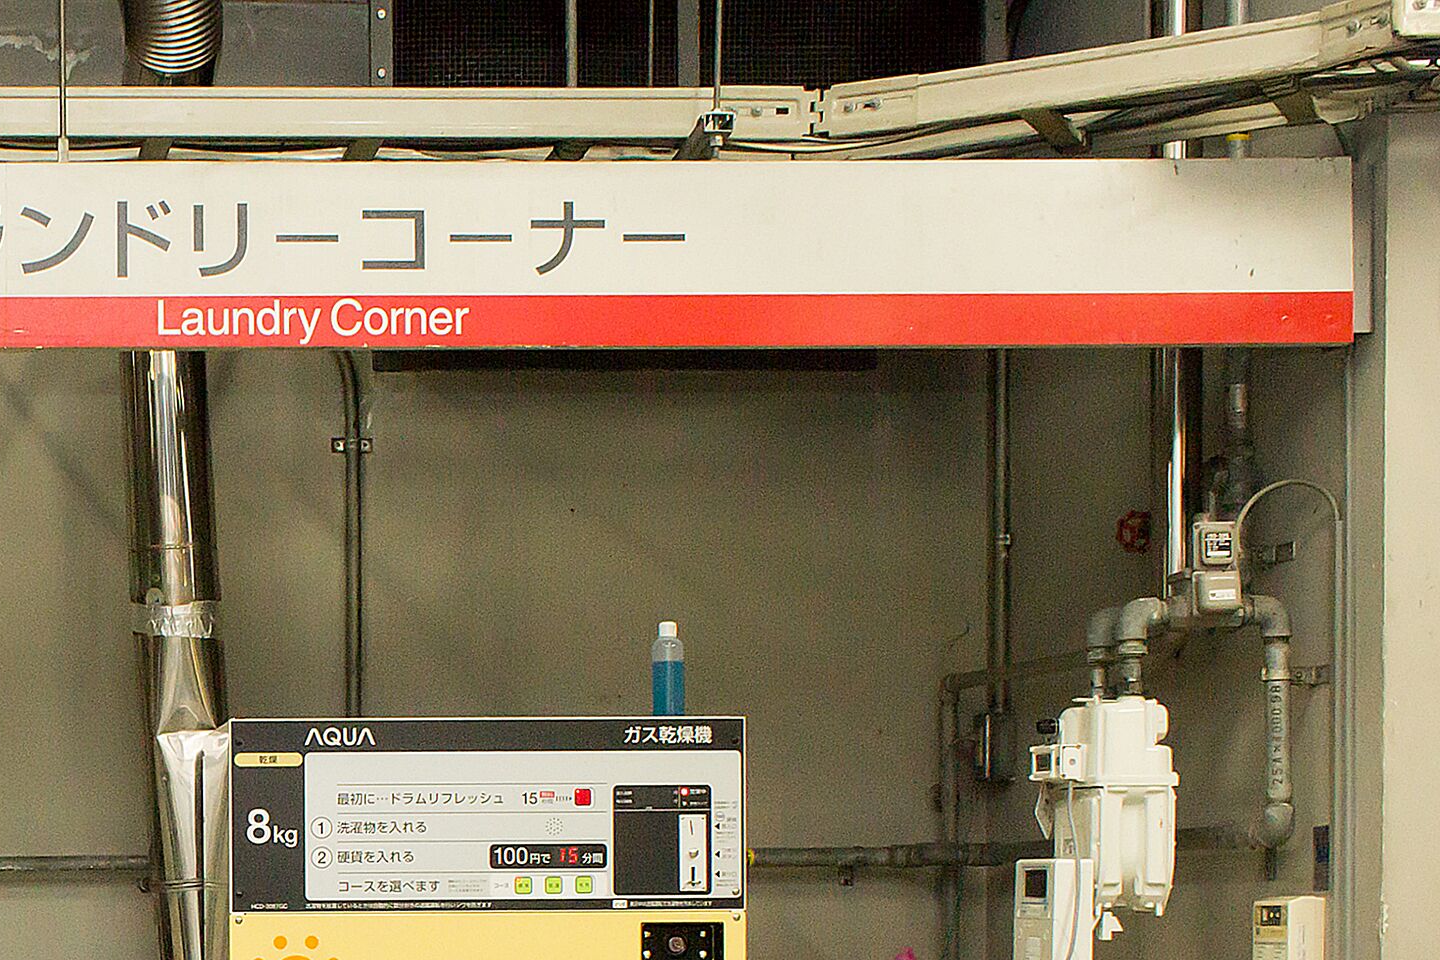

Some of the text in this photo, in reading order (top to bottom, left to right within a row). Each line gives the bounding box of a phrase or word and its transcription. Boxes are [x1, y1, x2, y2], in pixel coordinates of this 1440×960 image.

[157, 297, 470, 346] Laundry Corner
[304, 727, 376, 746] AQUA
[623, 725, 713, 744] ガス乾燥機
[521, 792, 538, 805] 15
[582, 852, 604, 865] 分間
[338, 880, 440, 893] コースを選べます
